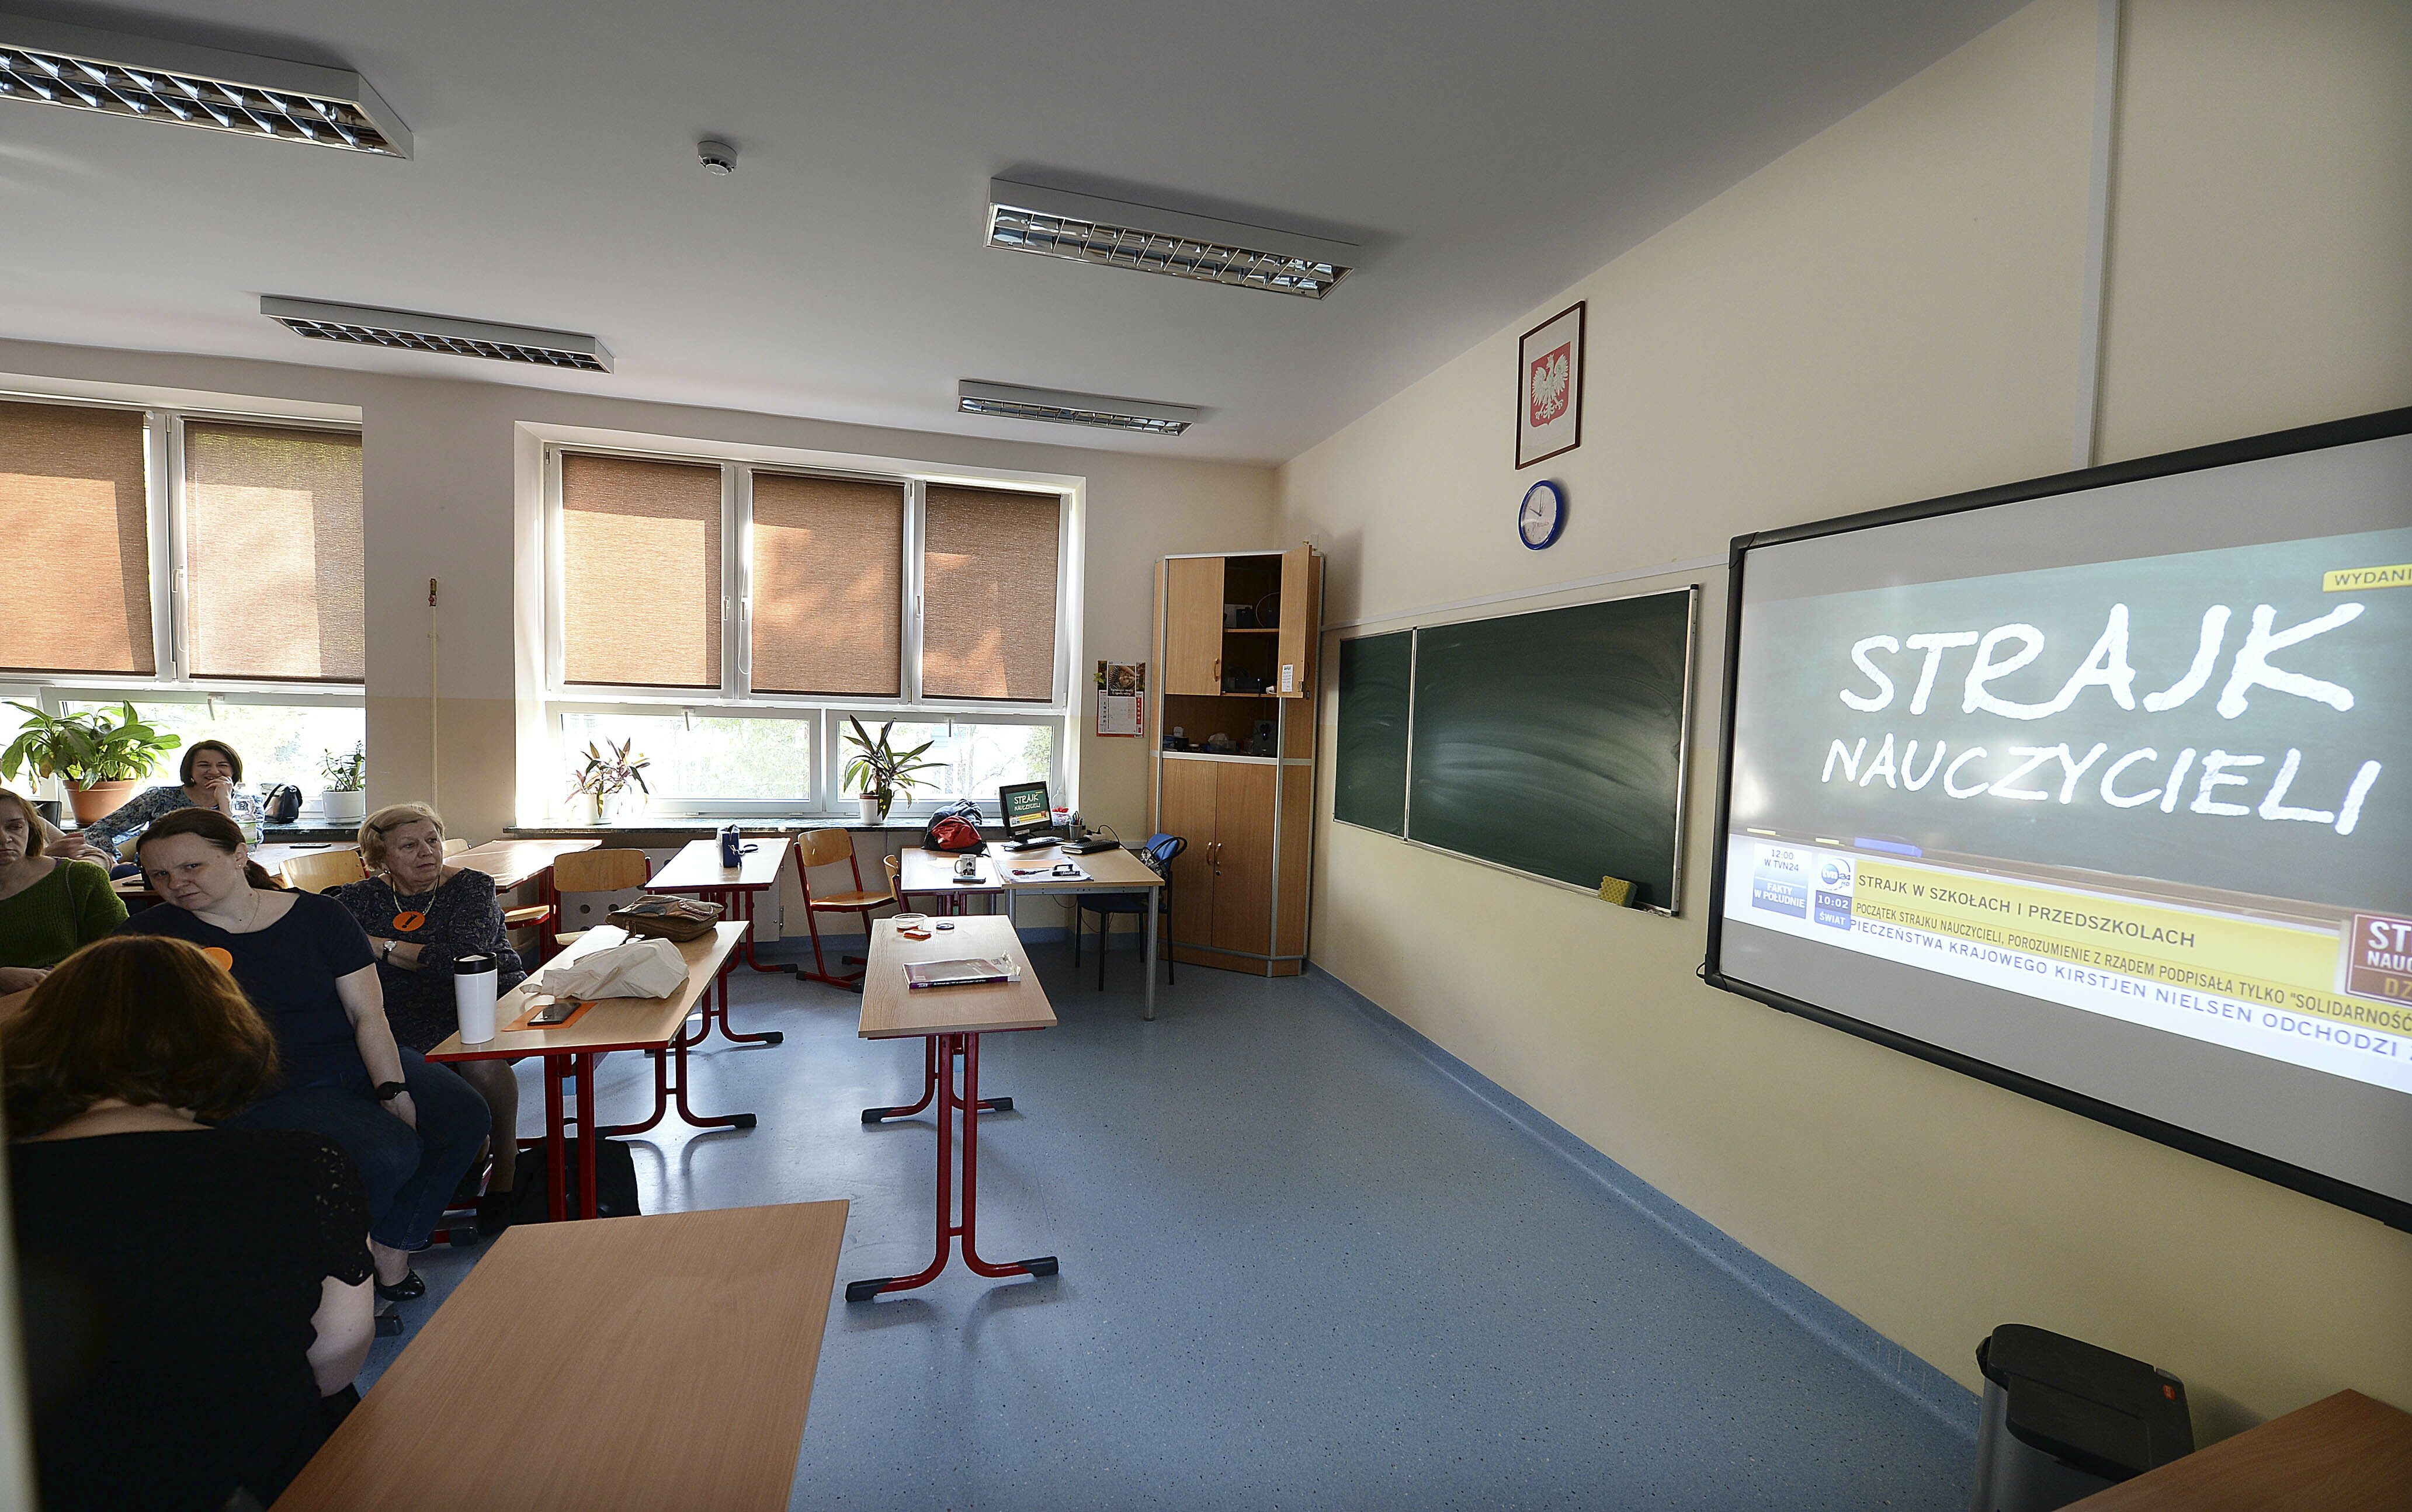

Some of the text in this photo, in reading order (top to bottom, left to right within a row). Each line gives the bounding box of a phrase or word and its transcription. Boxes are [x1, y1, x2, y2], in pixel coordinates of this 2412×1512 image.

[1839, 602, 2366, 721] STRAJK
[1821, 732, 2382, 836] NAUCZYCIELI
[1014, 794, 1039, 805] STRAJK
[1764, 858, 1799, 871] W TVN24
[1771, 850, 1794, 860] 12:00
[1767, 882, 1793, 895] FAKTY
[1754, 889, 1806, 908] W POŁUDNIE
[1817, 894, 1849, 909] 10:02
[1819, 910, 1846, 926] ŚWIAT
[1858, 875, 2195, 948] STRAJK W SZKOŁACH I PRZEDSZKOLACH
[2368, 920, 2412, 953] ST
[1856, 903, 1897, 920] POCZĄTEK
[1899, 912, 1937, 929] STRAJKU
[1940, 920, 2004, 945] NAUCZYCIELI,
[2008, 934, 2090, 962] POROZUMIENIE
[2094, 951, 2101, 965] Z
[2105, 954, 2154, 976] RZĄDEM
[2159, 965, 2233, 993] PODPISAŁA
[2239, 982, 2285, 1004] TYLKO
[1949, 941, 2047, 974] KRAJOWEGO
[2055, 965, 2146, 997] KIRSTJEN
[2156, 988, 2252, 1023] NIELSEN
[2262, 1013, 2397, 1057] ODCHODZI
